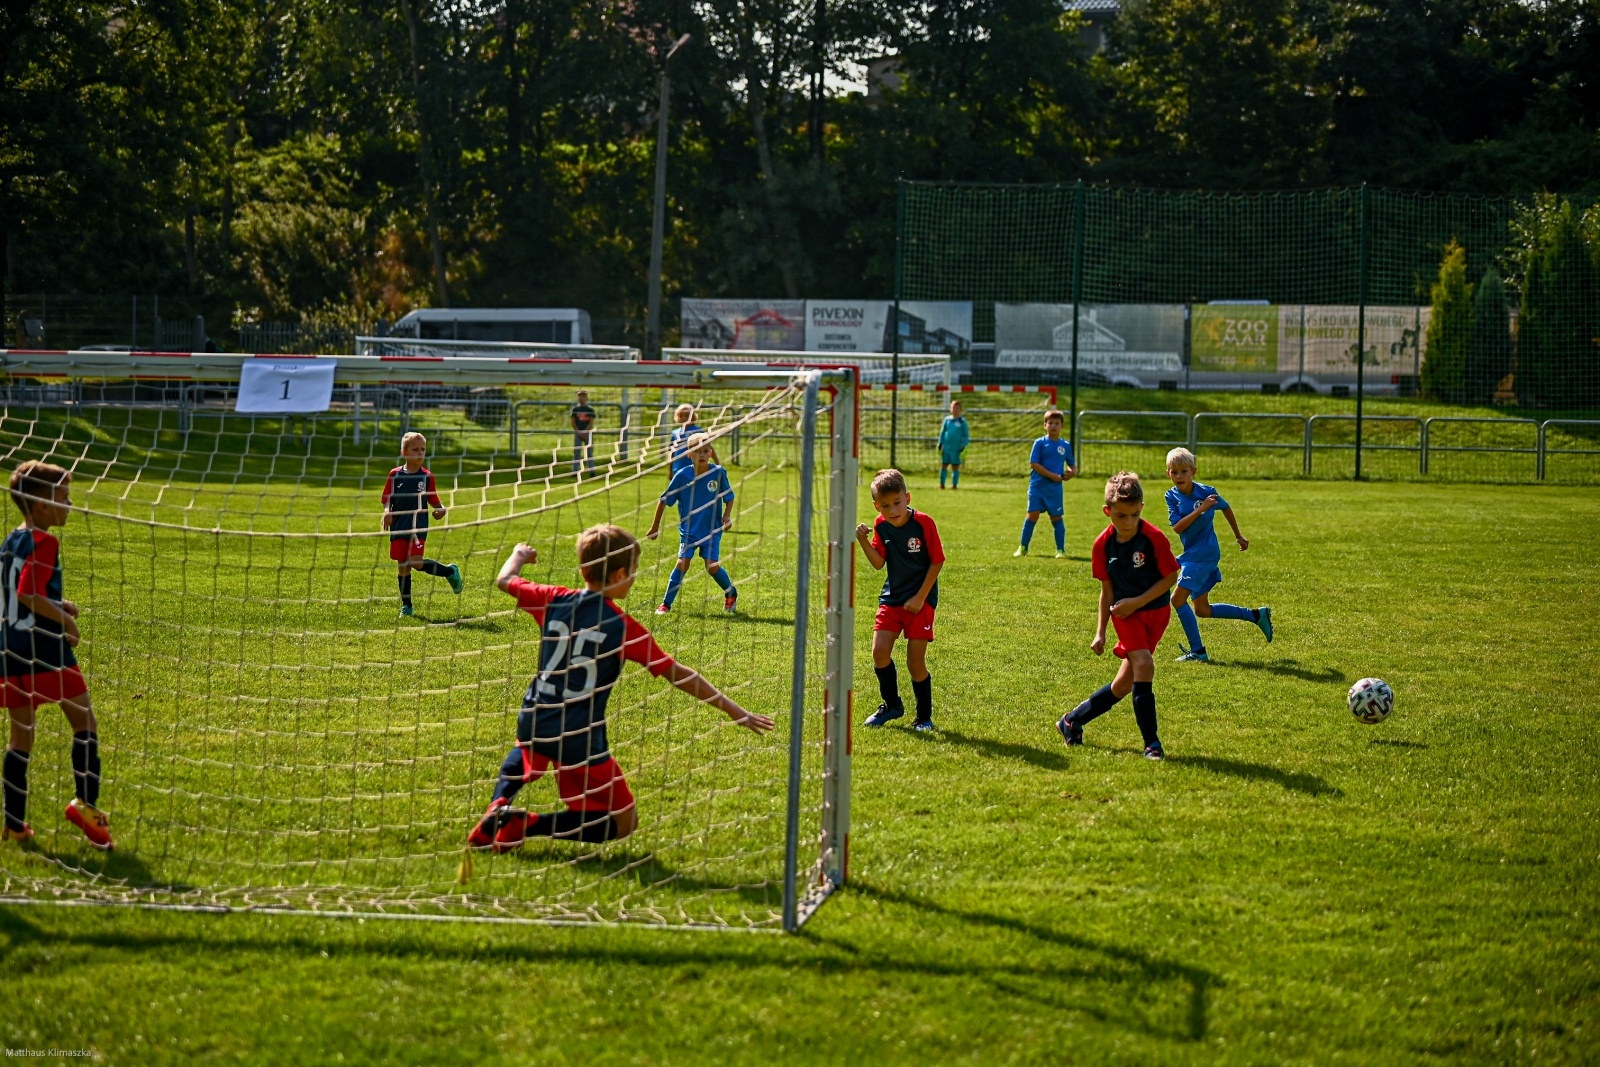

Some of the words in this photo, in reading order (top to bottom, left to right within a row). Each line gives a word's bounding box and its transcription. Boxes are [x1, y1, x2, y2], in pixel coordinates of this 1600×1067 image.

[812, 307, 864, 319] PIVEXIN
[813, 319, 863, 327] TECHNOLOGY
[1225, 318, 1268, 334] ZOO
[1285, 314, 1337, 327] WSYSTKO
[1366, 315, 1405, 328] WOJEGO
[1221, 333, 1267, 346] MAR
[1285, 327, 1345, 339] DOOWEGO
[279, 378, 292, 400] 1
[535, 620, 608, 699] 25
